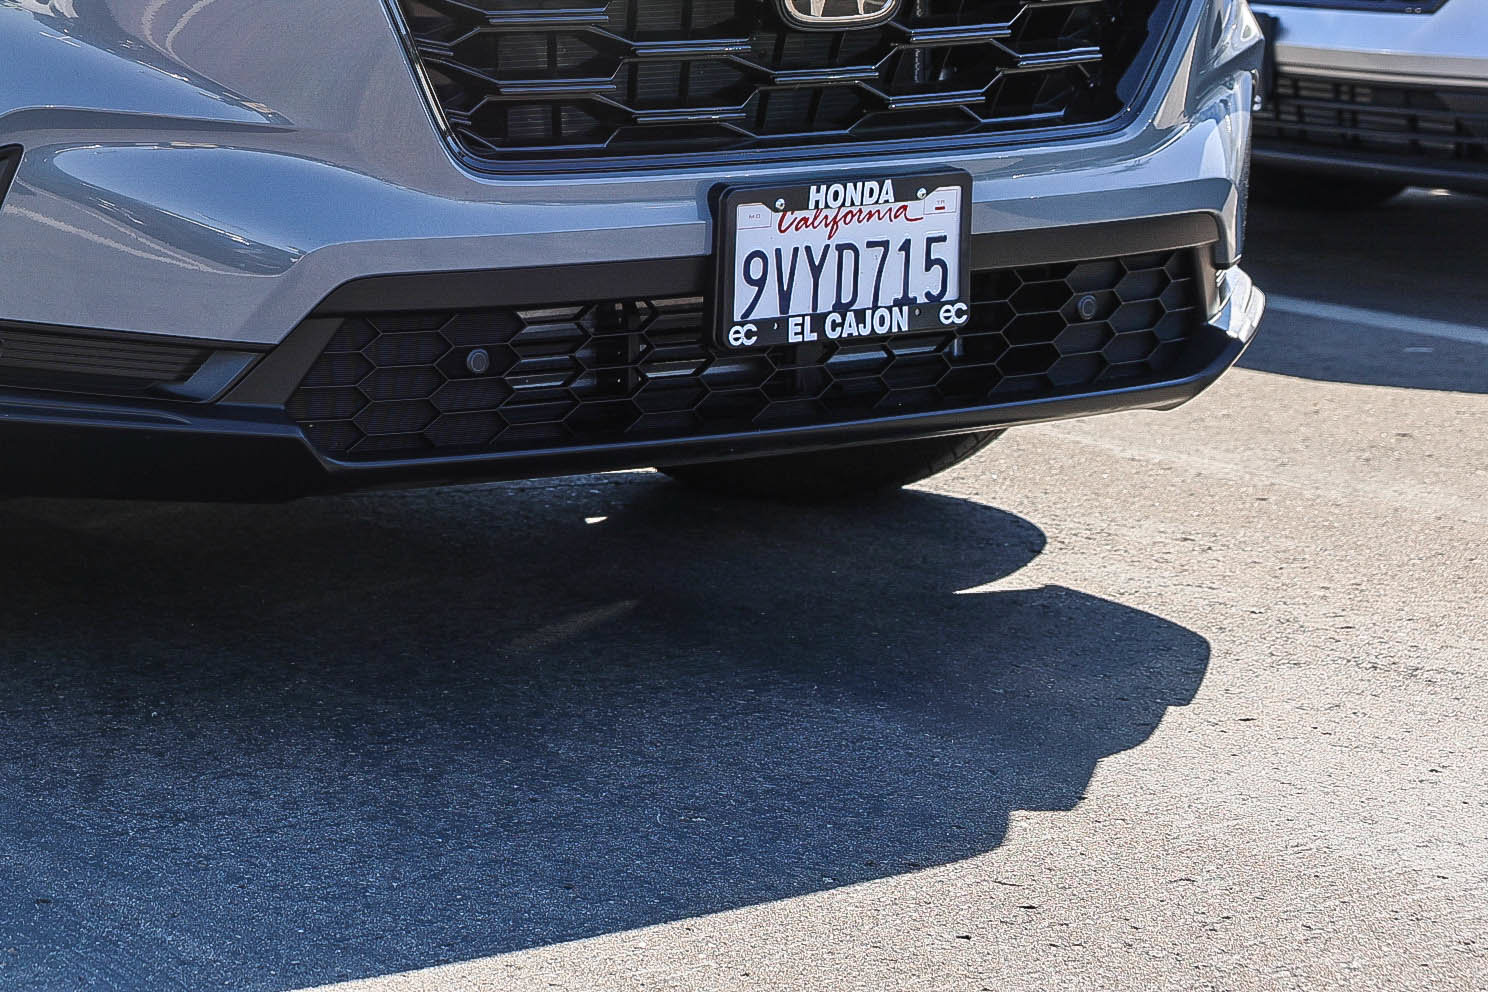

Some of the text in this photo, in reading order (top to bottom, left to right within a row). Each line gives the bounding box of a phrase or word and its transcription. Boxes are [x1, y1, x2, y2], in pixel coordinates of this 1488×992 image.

[808, 179, 895, 210] HONDA
[777, 204, 924, 241] California
[739, 234, 948, 321] 9VYD715
[788, 305, 909, 343] EL CAJON
